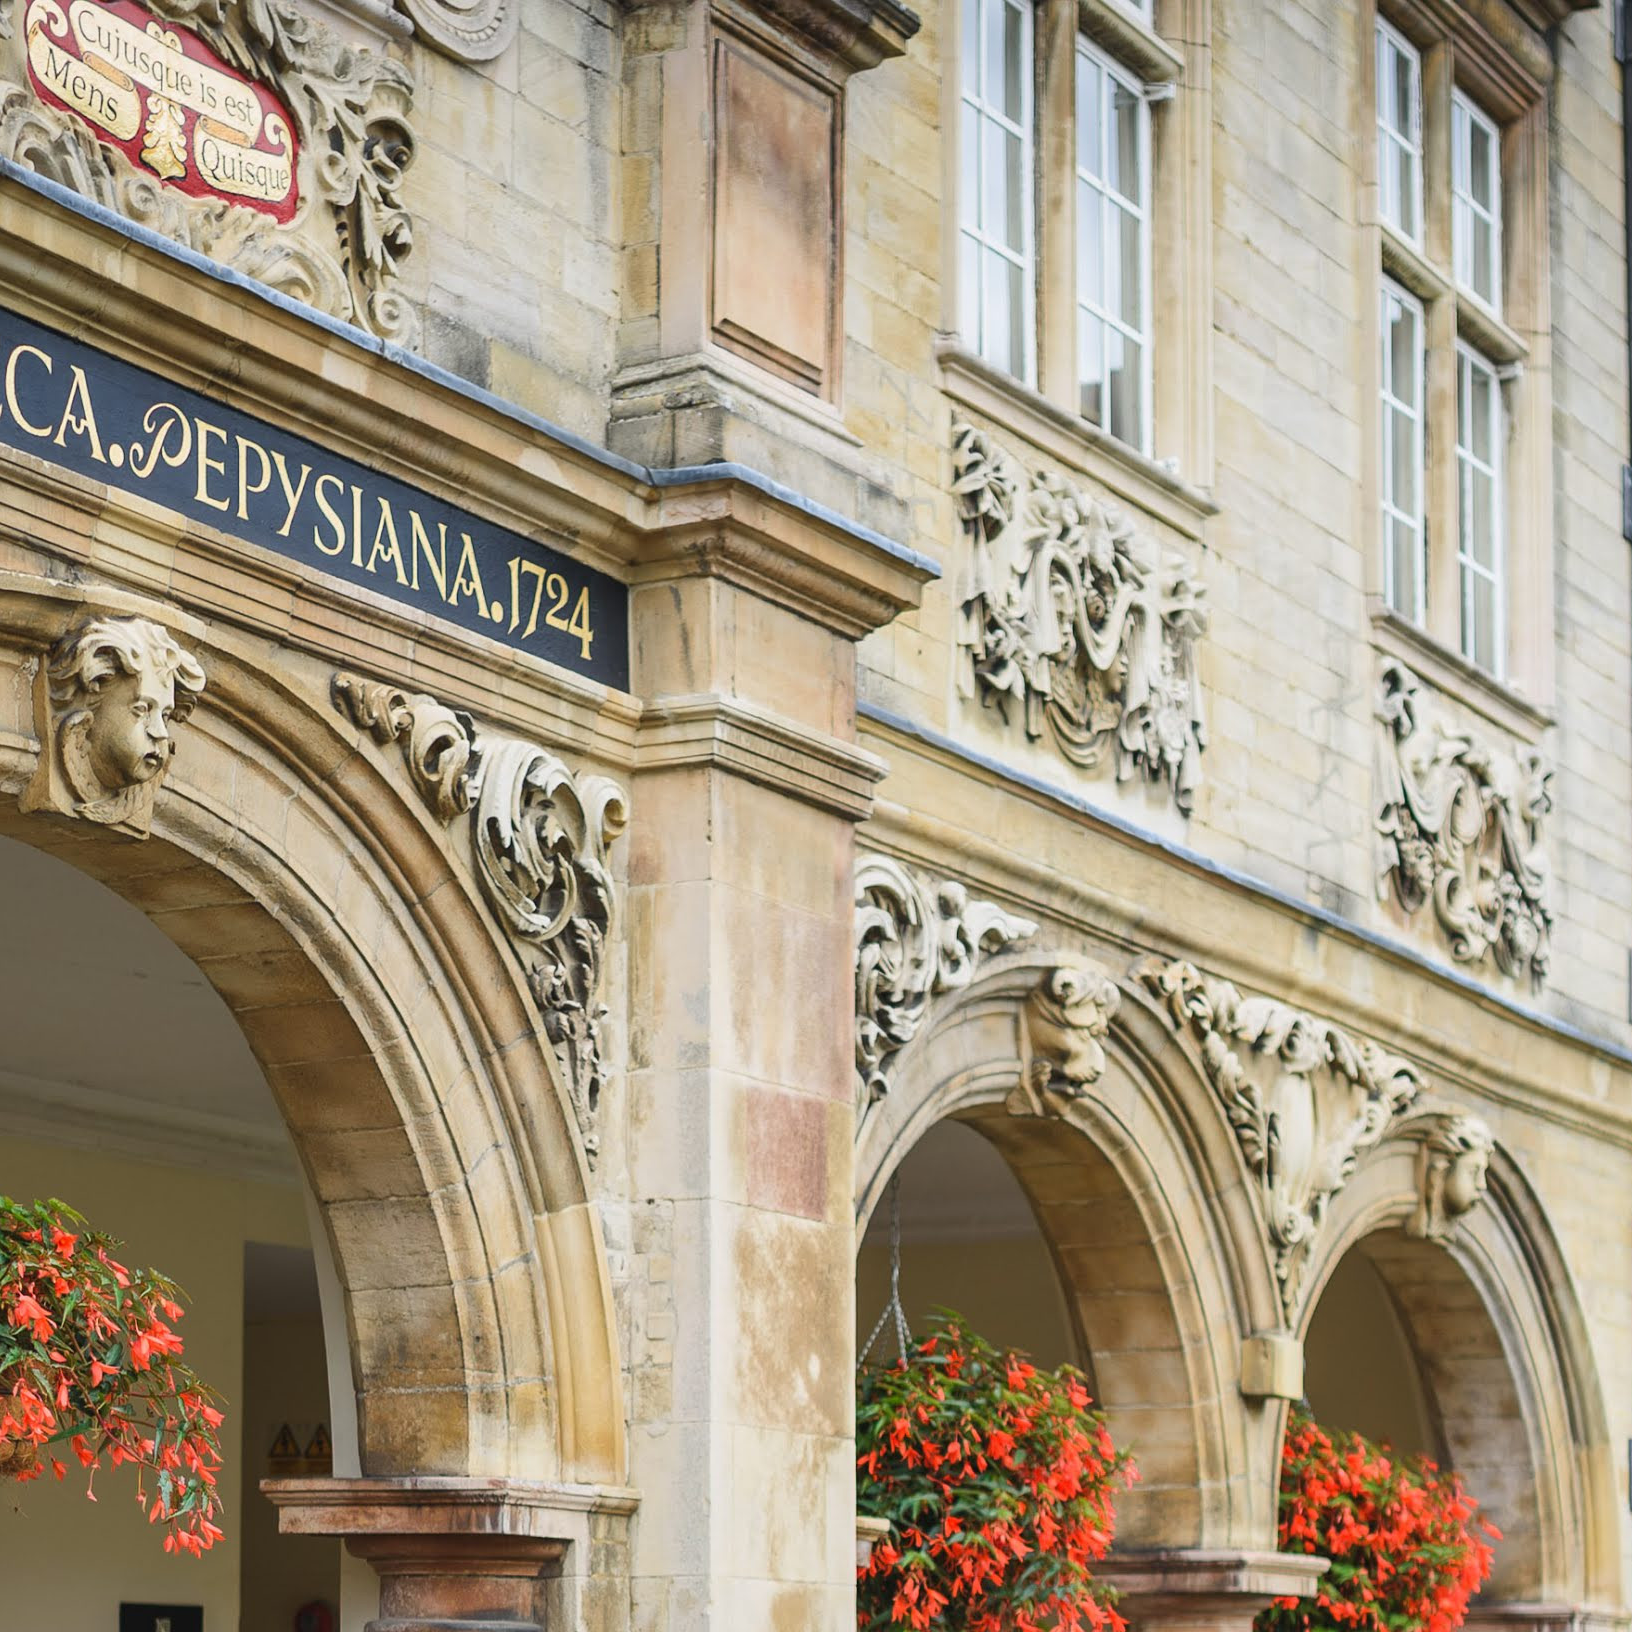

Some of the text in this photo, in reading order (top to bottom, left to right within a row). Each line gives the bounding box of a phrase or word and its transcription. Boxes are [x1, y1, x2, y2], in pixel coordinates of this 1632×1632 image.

[45, 48, 118, 121] Mens
[78, 9, 256, 127] Cujusque is est
[201, 139, 289, 191] Quisque
[506, 556, 595, 660] 1724
